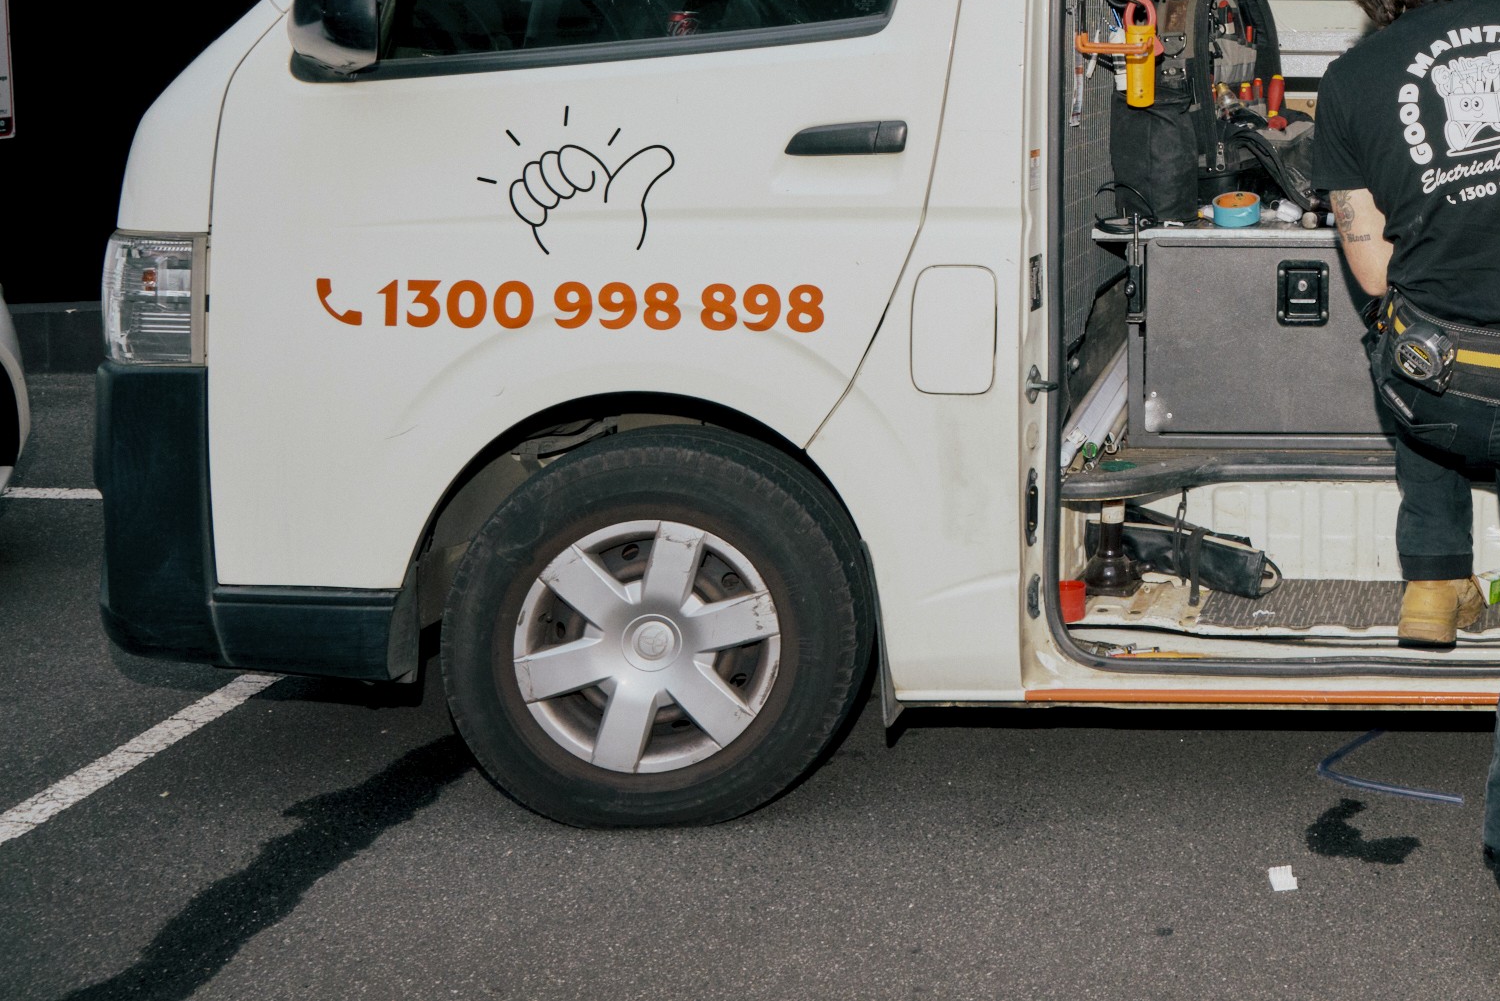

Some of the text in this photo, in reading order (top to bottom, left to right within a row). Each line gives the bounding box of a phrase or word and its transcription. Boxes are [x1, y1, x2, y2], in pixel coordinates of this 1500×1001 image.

[1398, 83, 1433, 165] GOOD
[1459, 182, 1497, 201] 1300
[377, 279, 825, 333] 1300 998 898
